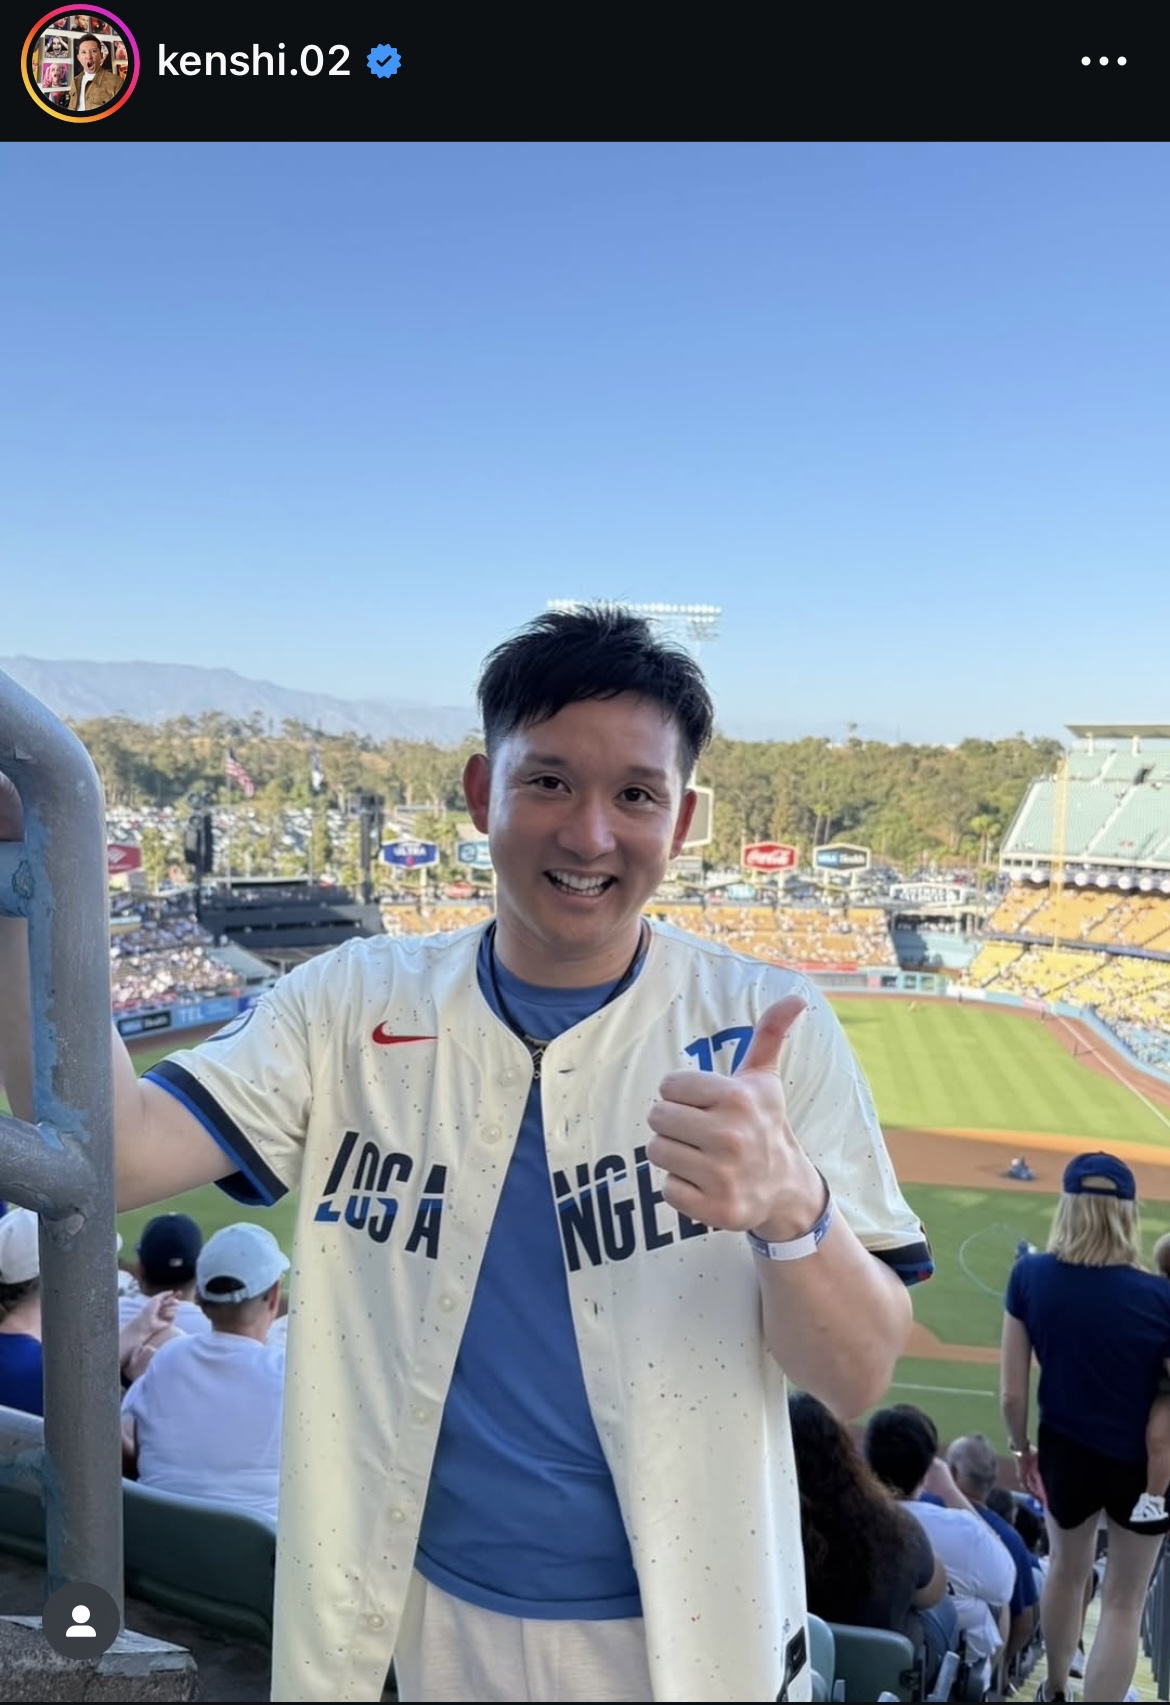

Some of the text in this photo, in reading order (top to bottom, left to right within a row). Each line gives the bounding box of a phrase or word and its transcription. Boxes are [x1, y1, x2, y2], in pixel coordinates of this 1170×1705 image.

[685, 1026, 754, 1076] 17
[314, 1131, 413, 1243] LOS
[405, 1164, 447, 1260] A
